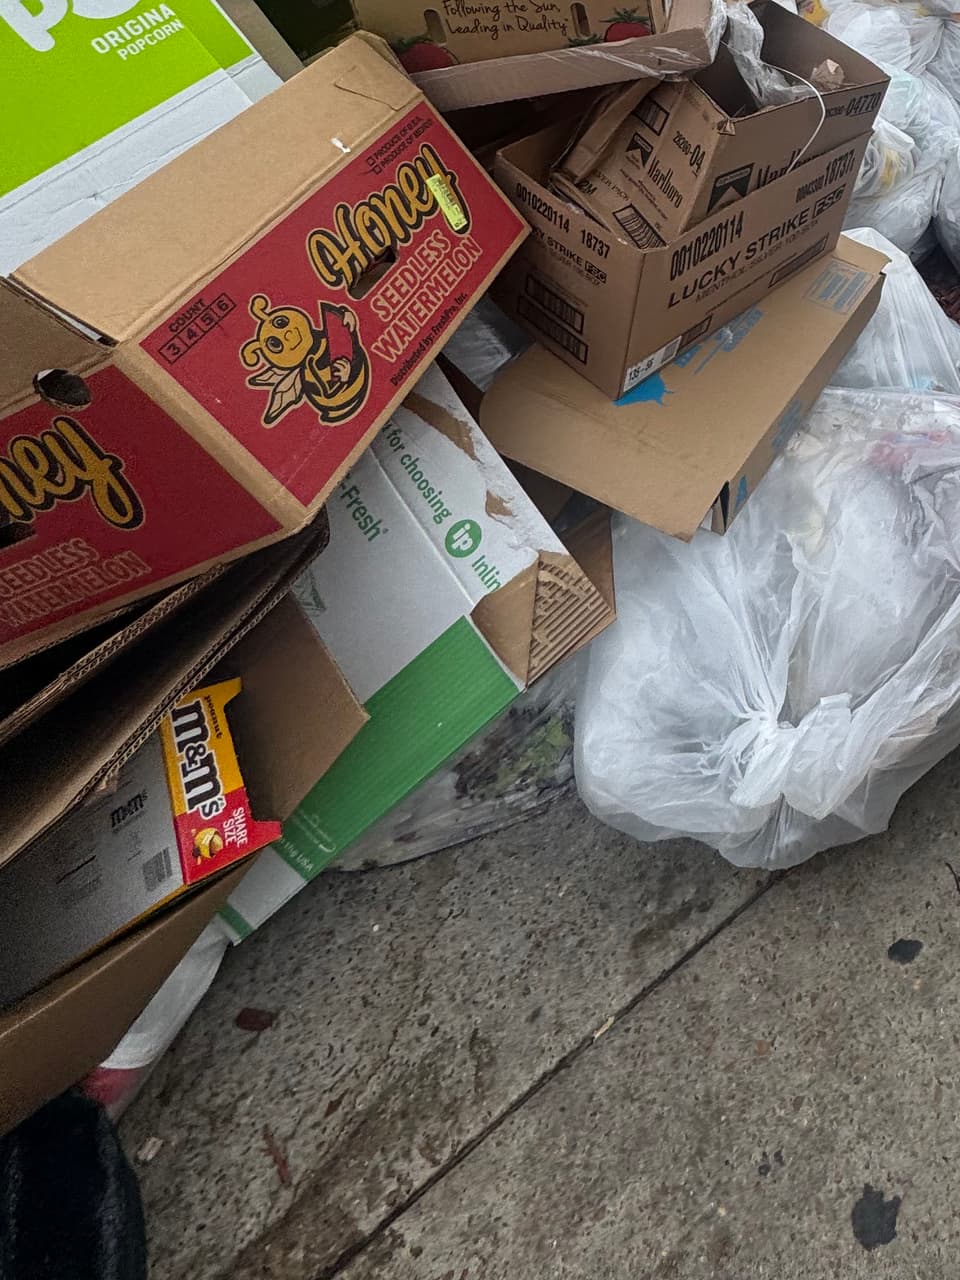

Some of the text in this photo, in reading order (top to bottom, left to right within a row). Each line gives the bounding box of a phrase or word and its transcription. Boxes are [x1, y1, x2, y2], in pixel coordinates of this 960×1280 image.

[117, 19, 185, 61] POPCORN
[445, 18, 499, 40] Leading
[502, 21, 514, 32] in
[648, 156, 684, 209] Marlboro
[515, 182, 570, 234] 0010220114
[580, 228, 611, 260] 18737
[670, 210, 745, 281] 0010220114
[370, 229, 451, 322] SEEDLESS
[547, 238, 583, 266] STRIKE
[668, 251, 741, 309] LUCKY
[745, 208, 810, 261] STRIKE
[168, 298, 207, 333] COUNT
[371, 235, 483, 362] WATERMELON
[166, 299, 229, 356] 3 4 5 6
[390, 342, 427, 387] Distributed
[386, 428, 453, 525] for choosing
[204, 694, 224, 740] peanut
[222, 819, 237, 847] SIZE
[232, 806, 249, 848] SHARE
